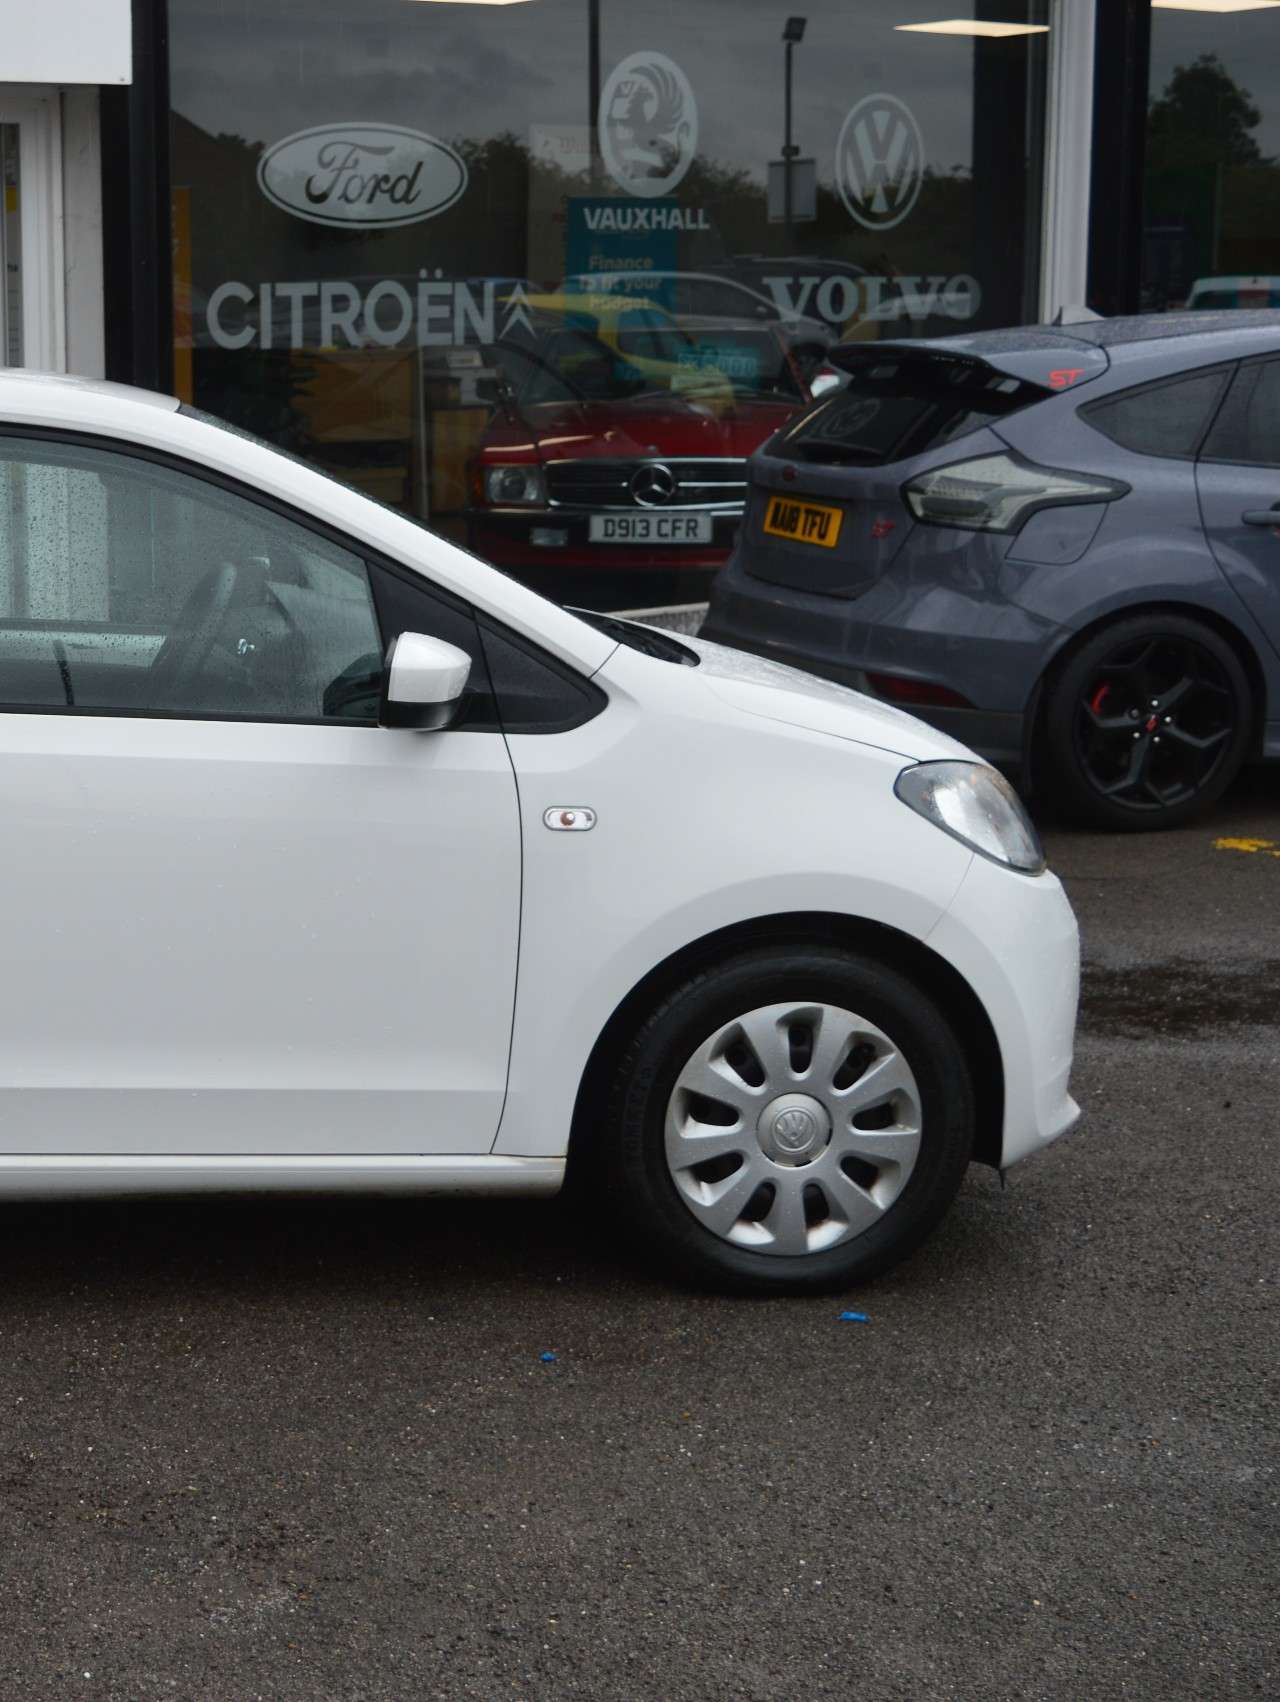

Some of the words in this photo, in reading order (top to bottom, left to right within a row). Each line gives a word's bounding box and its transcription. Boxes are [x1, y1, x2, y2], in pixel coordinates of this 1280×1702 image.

[305, 140, 424, 205] Ford
[583, 207, 711, 230] VAUXHALL
[588, 255, 653, 270] Finance
[624, 279, 663, 293] your
[205, 268, 496, 350] CITROËN
[762, 274, 982, 323] VOLVO
[1048, 368, 1085, 389] ST
[603, 518, 651, 538] D913
[656, 518, 699, 538] CFR
[801, 508, 833, 540] TFU
